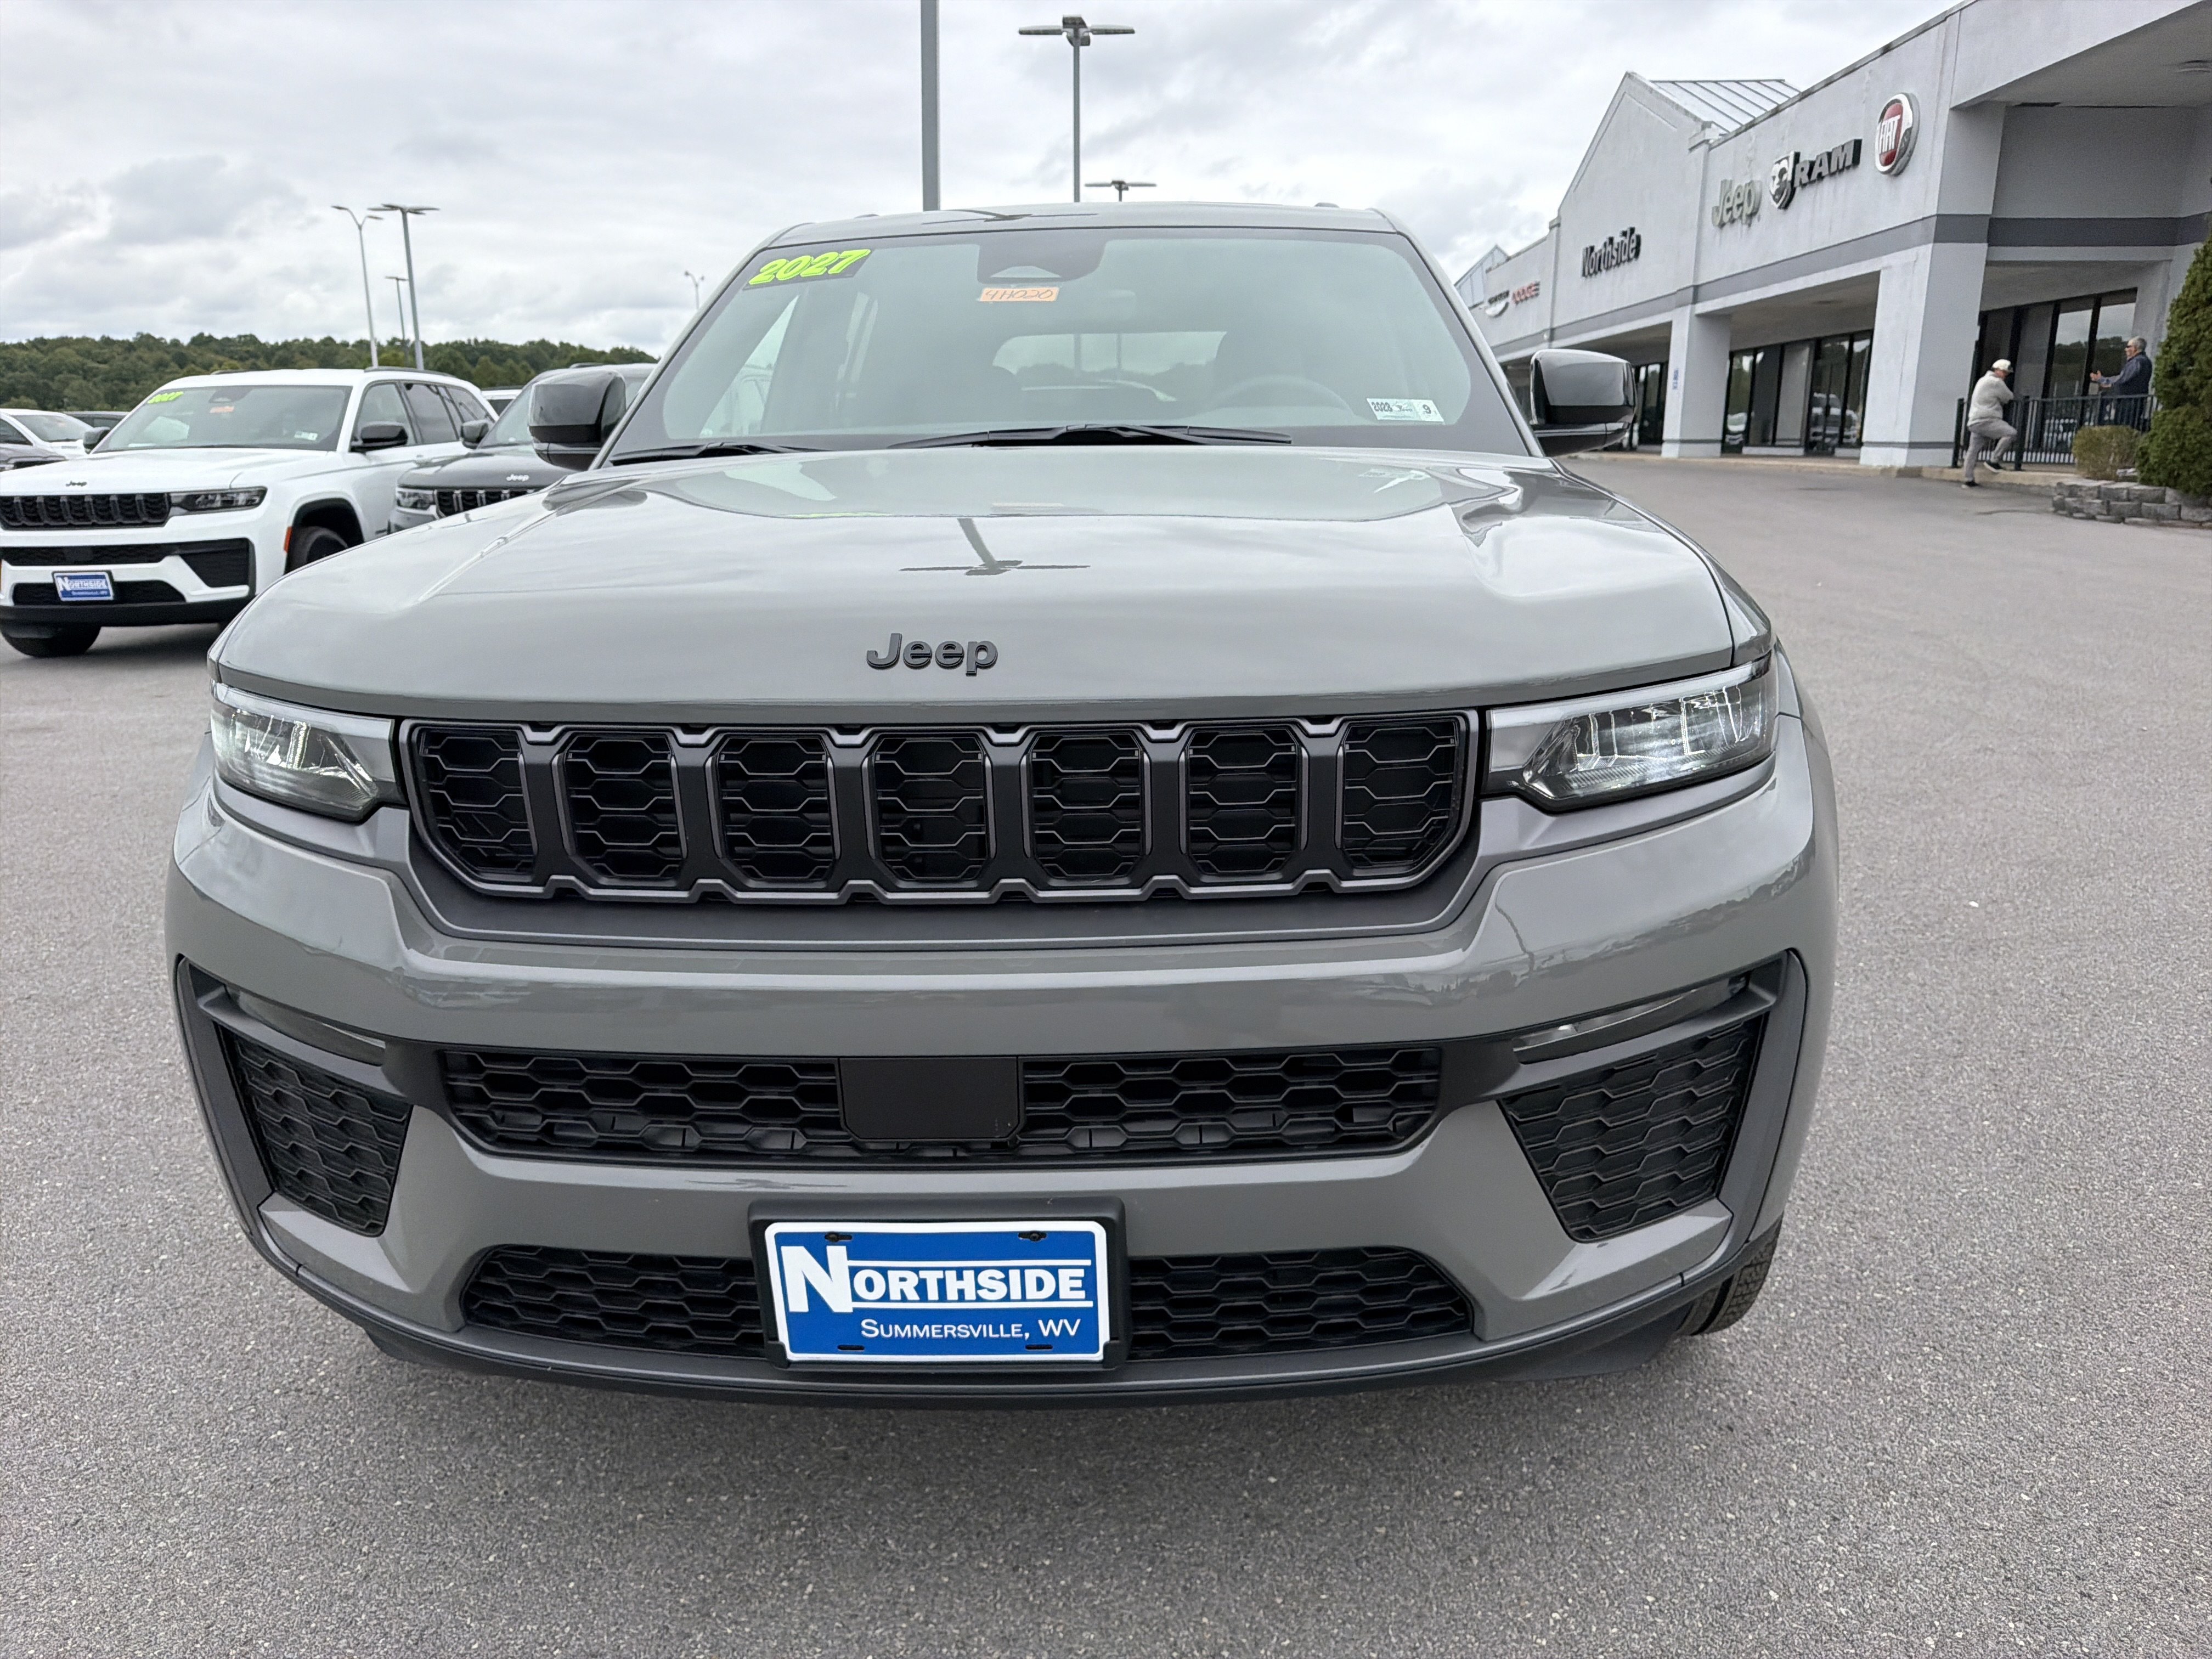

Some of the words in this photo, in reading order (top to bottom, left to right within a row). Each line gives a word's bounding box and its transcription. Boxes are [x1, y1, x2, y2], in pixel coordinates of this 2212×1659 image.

[1877, 114, 1901, 155] FIAT
[1793, 139, 1862, 188] RAM
[1712, 179, 1763, 229] Jeep
[749, 249, 871, 285] 2027
[1582, 227, 1641, 278] Northside
[1422, 404, 1431, 414] 9
[866, 633, 998, 676] Jeep
[781, 1245, 1086, 1313] NORTHSIDE
[861, 1318, 1030, 1340] SUMMERSVILLE,
[1038, 1318, 1081, 1337] WV
